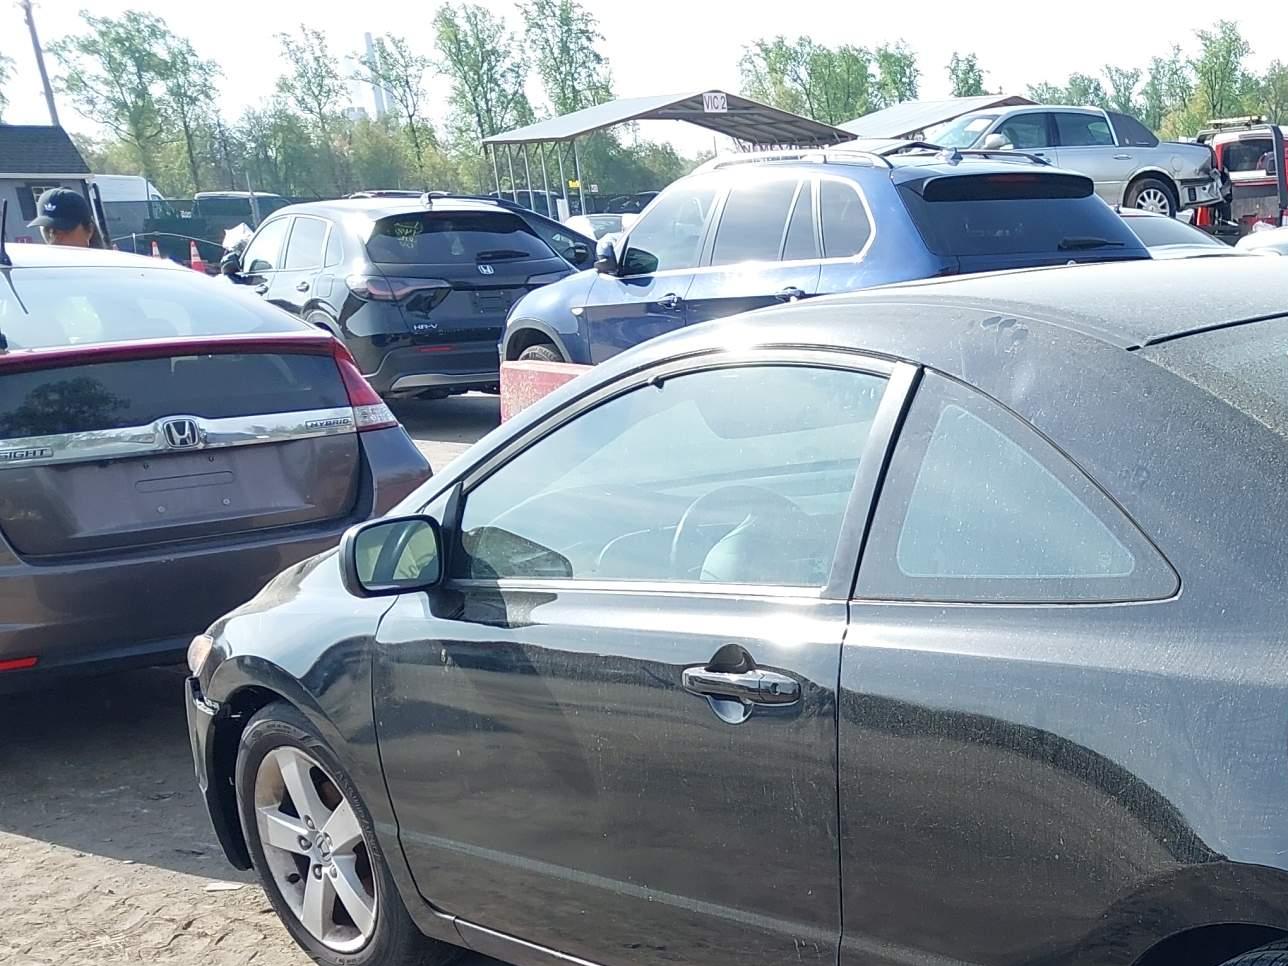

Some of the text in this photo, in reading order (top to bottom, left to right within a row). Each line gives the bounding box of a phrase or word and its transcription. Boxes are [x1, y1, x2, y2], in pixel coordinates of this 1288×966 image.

[703, 95, 727, 110] VIC 2
[413, 323, 438, 331] HR-V
[310, 418, 350, 428] HYBRID
